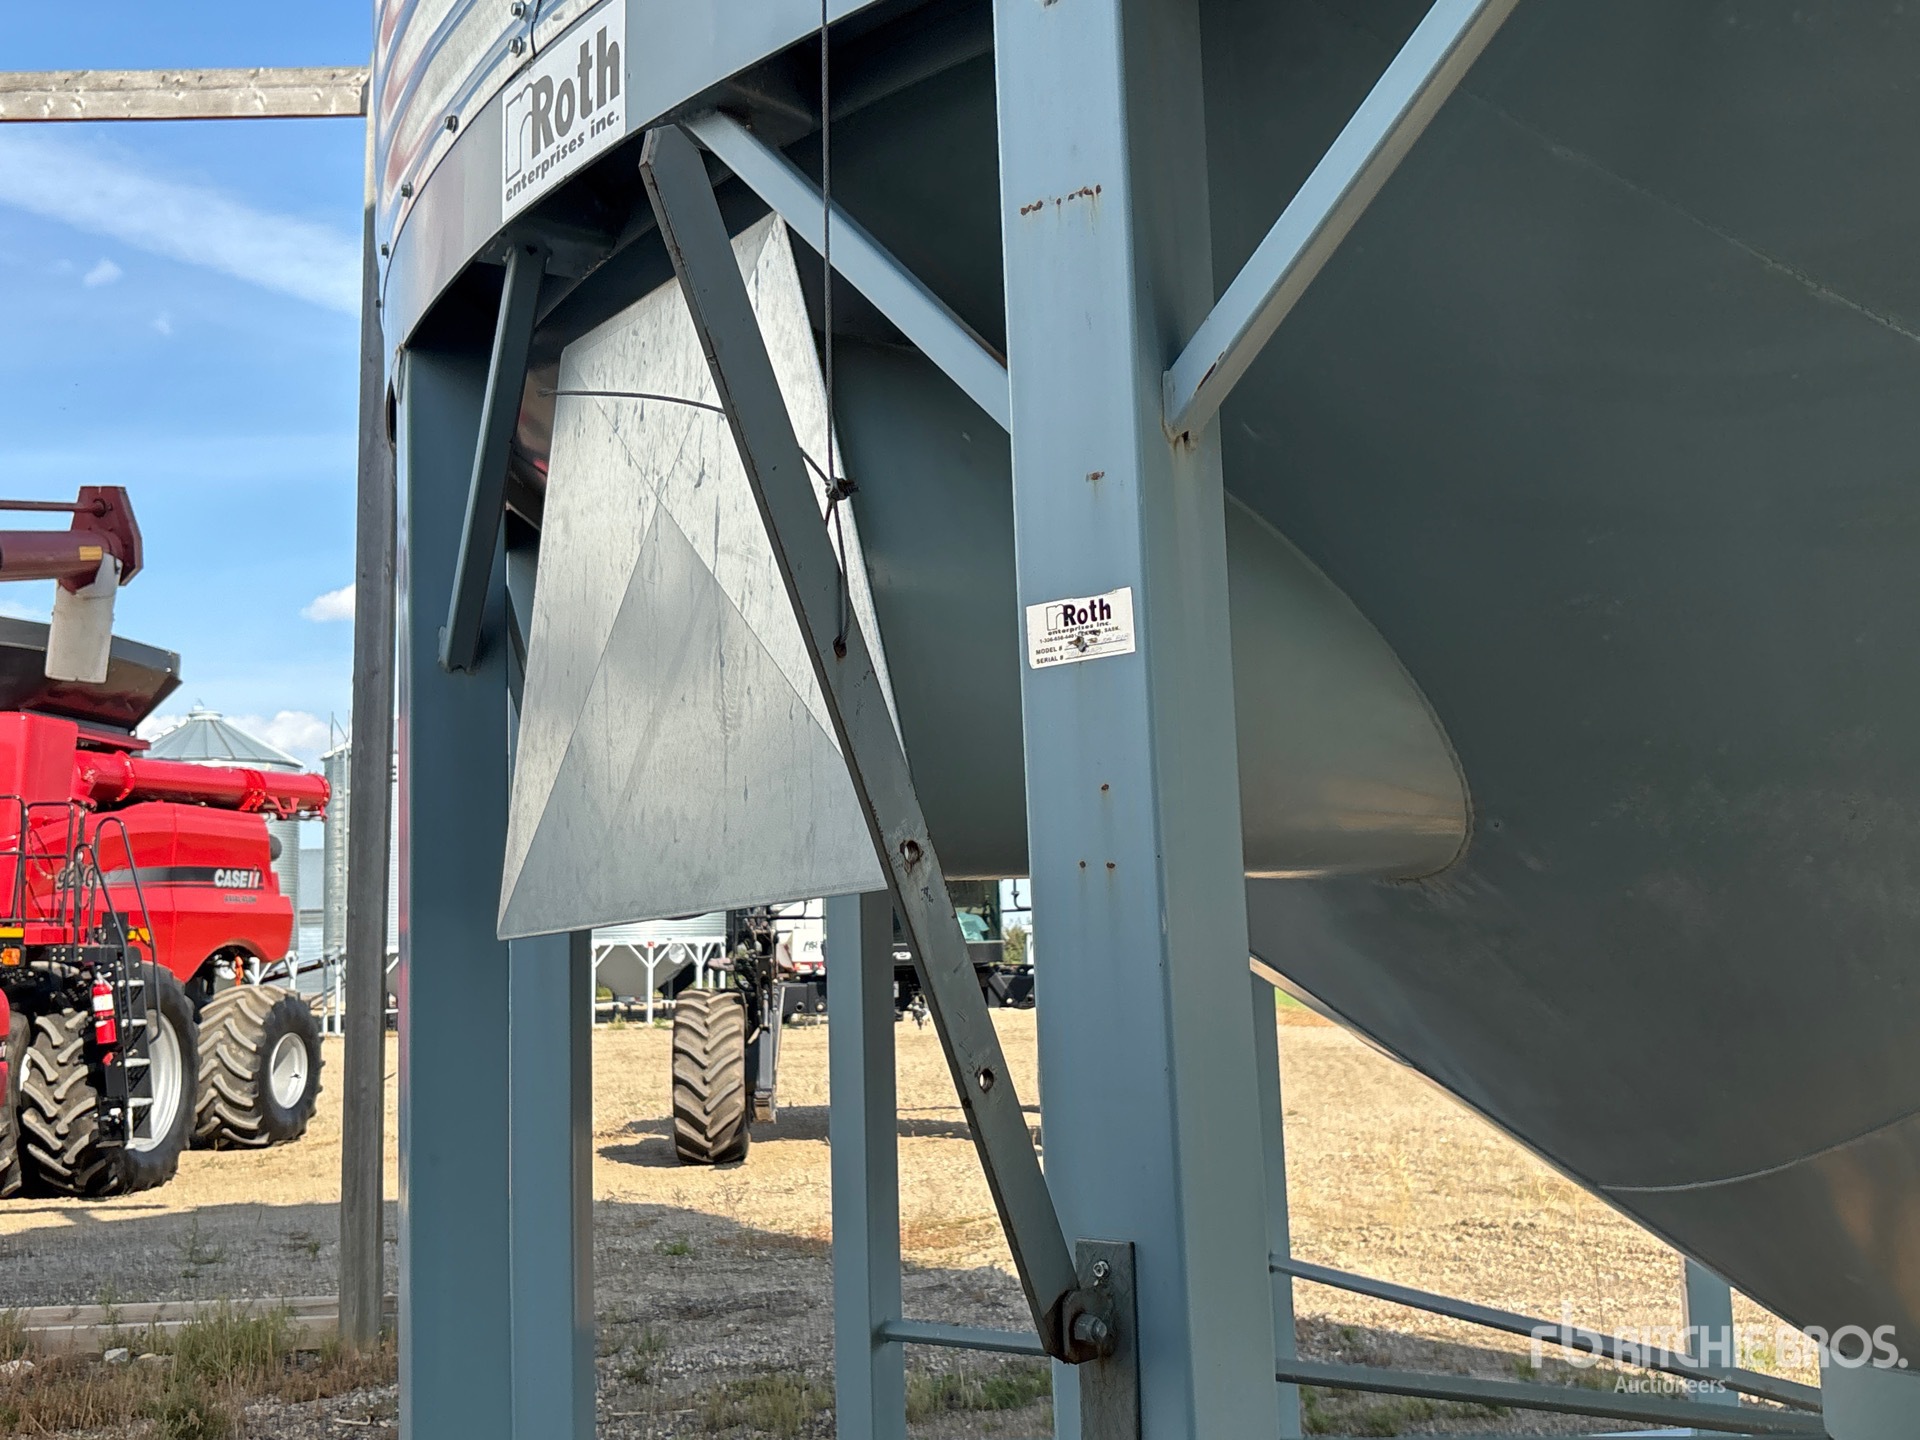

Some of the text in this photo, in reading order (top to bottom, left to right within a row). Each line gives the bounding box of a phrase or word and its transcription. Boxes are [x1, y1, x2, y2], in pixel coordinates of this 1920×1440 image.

[531, 25, 620, 160] Roth
[505, 110, 620, 202] enterprises inc.
[1063, 598, 1111, 627] Roth
[1047, 624, 1094, 636] enterprises
[1035, 647, 1057, 655] MODEL
[1036, 656, 1058, 664] SERIAL
